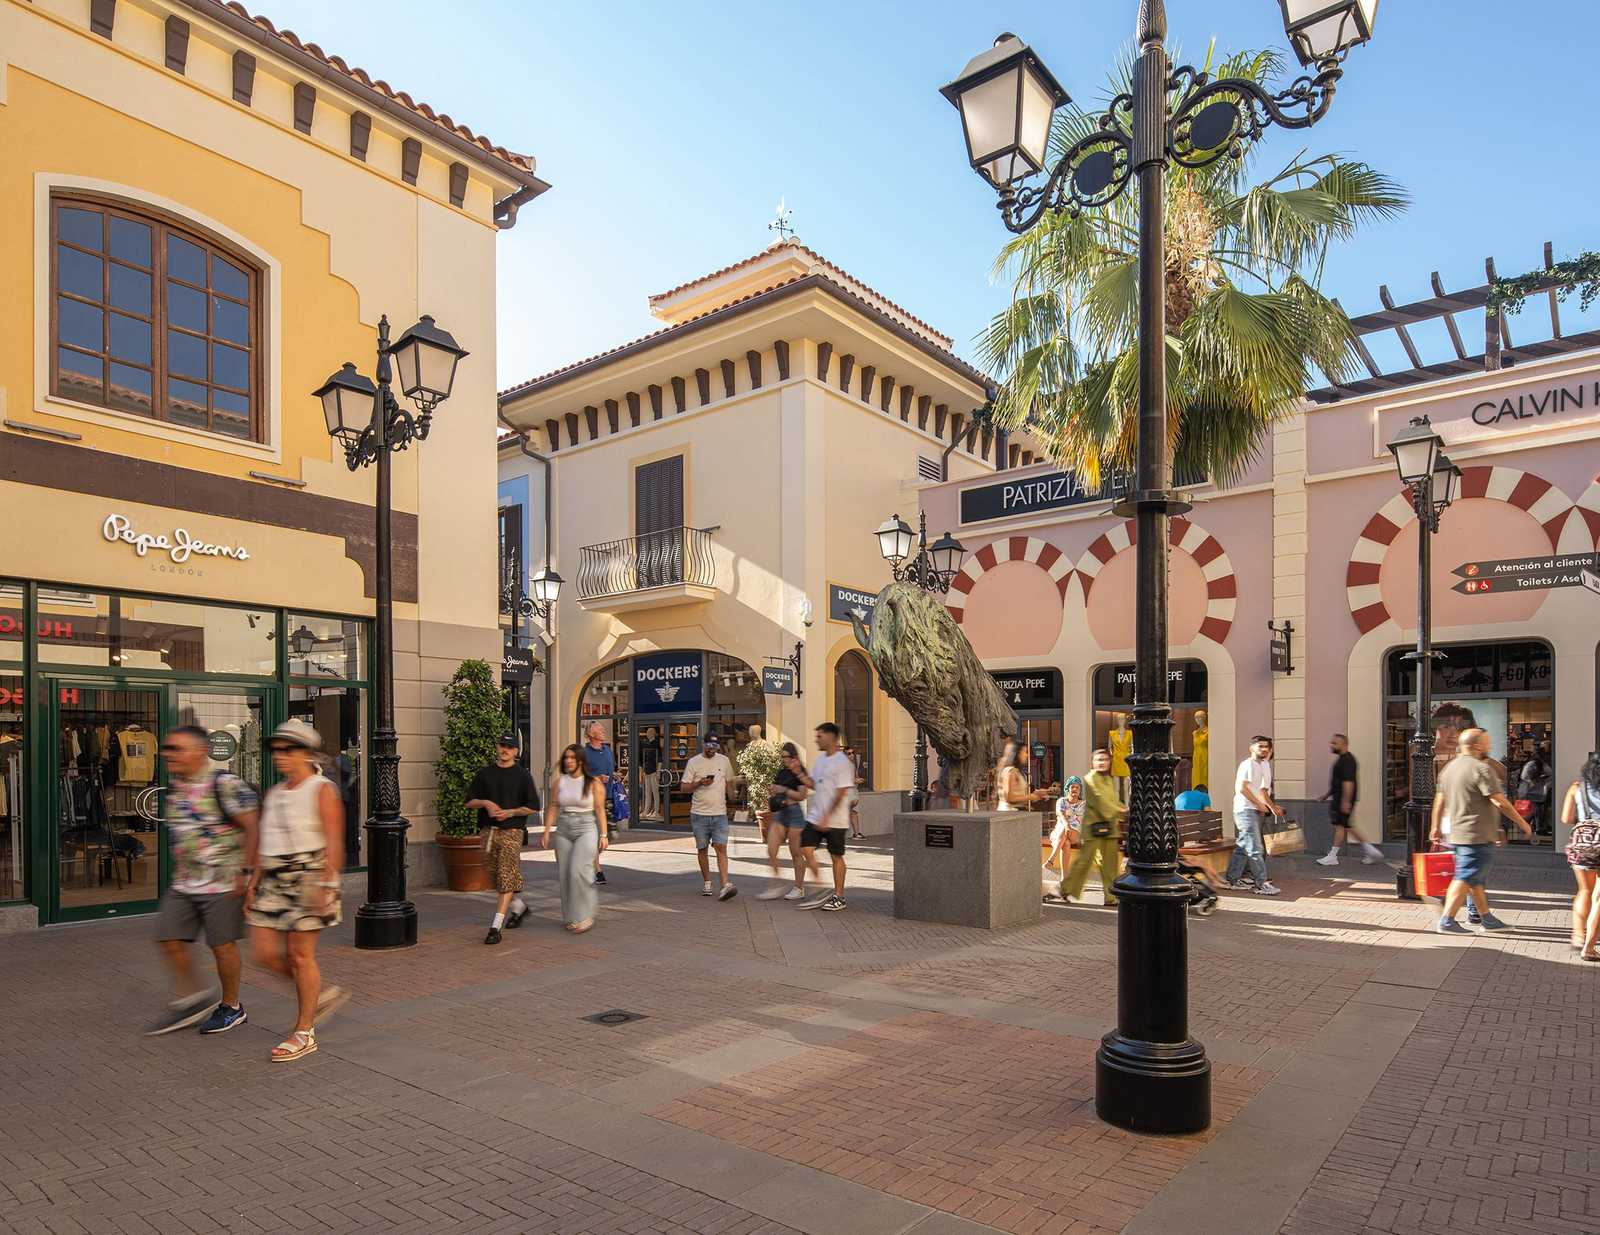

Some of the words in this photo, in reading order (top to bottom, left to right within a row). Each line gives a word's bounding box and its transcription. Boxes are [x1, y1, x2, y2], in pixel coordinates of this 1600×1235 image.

[1471, 384, 1583, 426] CALVIN
[103, 513, 172, 557] Pepe
[170, 528, 250, 563] Jeans
[1494, 561, 1541, 573] Atención
[1543, 559, 1554, 569] al
[1556, 558, 1593, 568] cliente
[1560, 575, 1580, 584] Ase
[637, 665, 699, 682] DOCKERS
[765, 671, 791, 682] DOCKERS
[1025, 678, 1046, 689] PEPE
